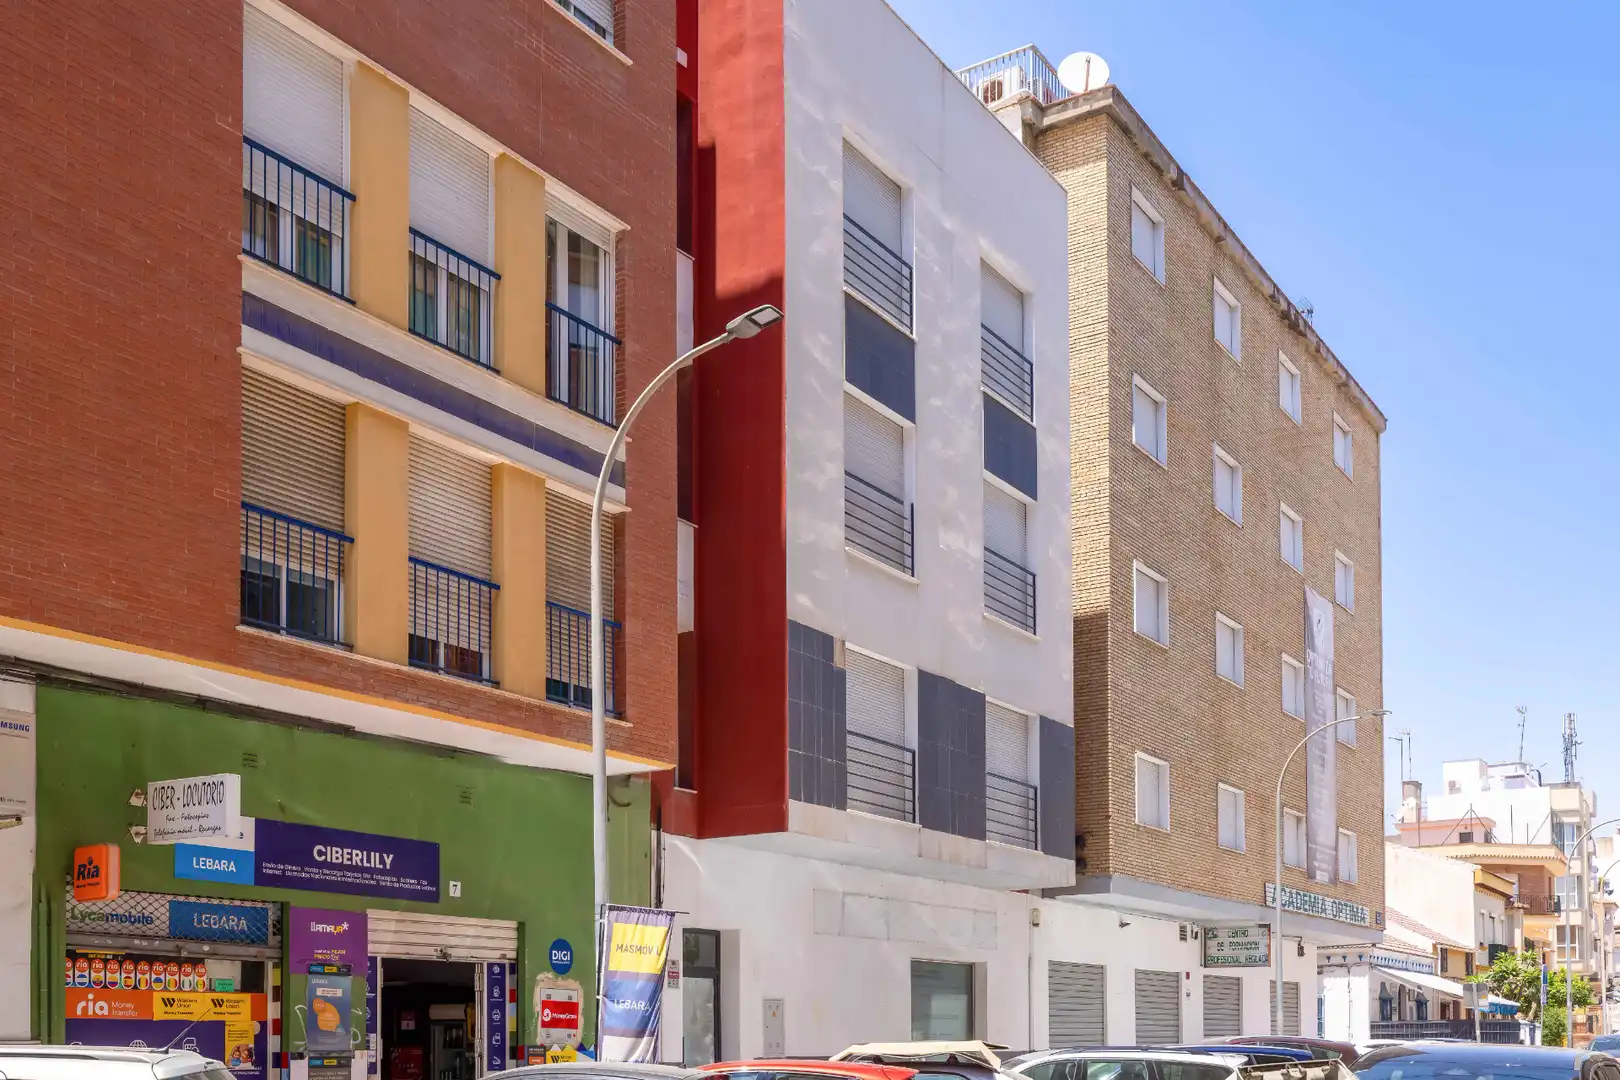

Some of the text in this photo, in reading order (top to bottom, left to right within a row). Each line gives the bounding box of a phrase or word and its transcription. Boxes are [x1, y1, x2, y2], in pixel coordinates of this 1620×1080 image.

[152, 785, 176, 811] CIBER
[182, 780, 225, 808] LOCUTORIO
[313, 844, 394, 870] CIBERLILY
[76, 856, 100, 881] Ria
[192, 856, 237, 873] LEBARA
[192, 912, 248, 931] LEBARA
[551, 950, 571, 960] DIGI
[615, 944, 661, 956] MASMÓVL
[92, 960, 103, 968] ria
[107, 961, 118, 969] ria
[123, 962, 134, 970] ria
[138, 962, 149, 971] ria
[76, 992, 109, 1016] ria
[111, 1001, 135, 1009] Money
[614, 998, 651, 1011] LEBARA
